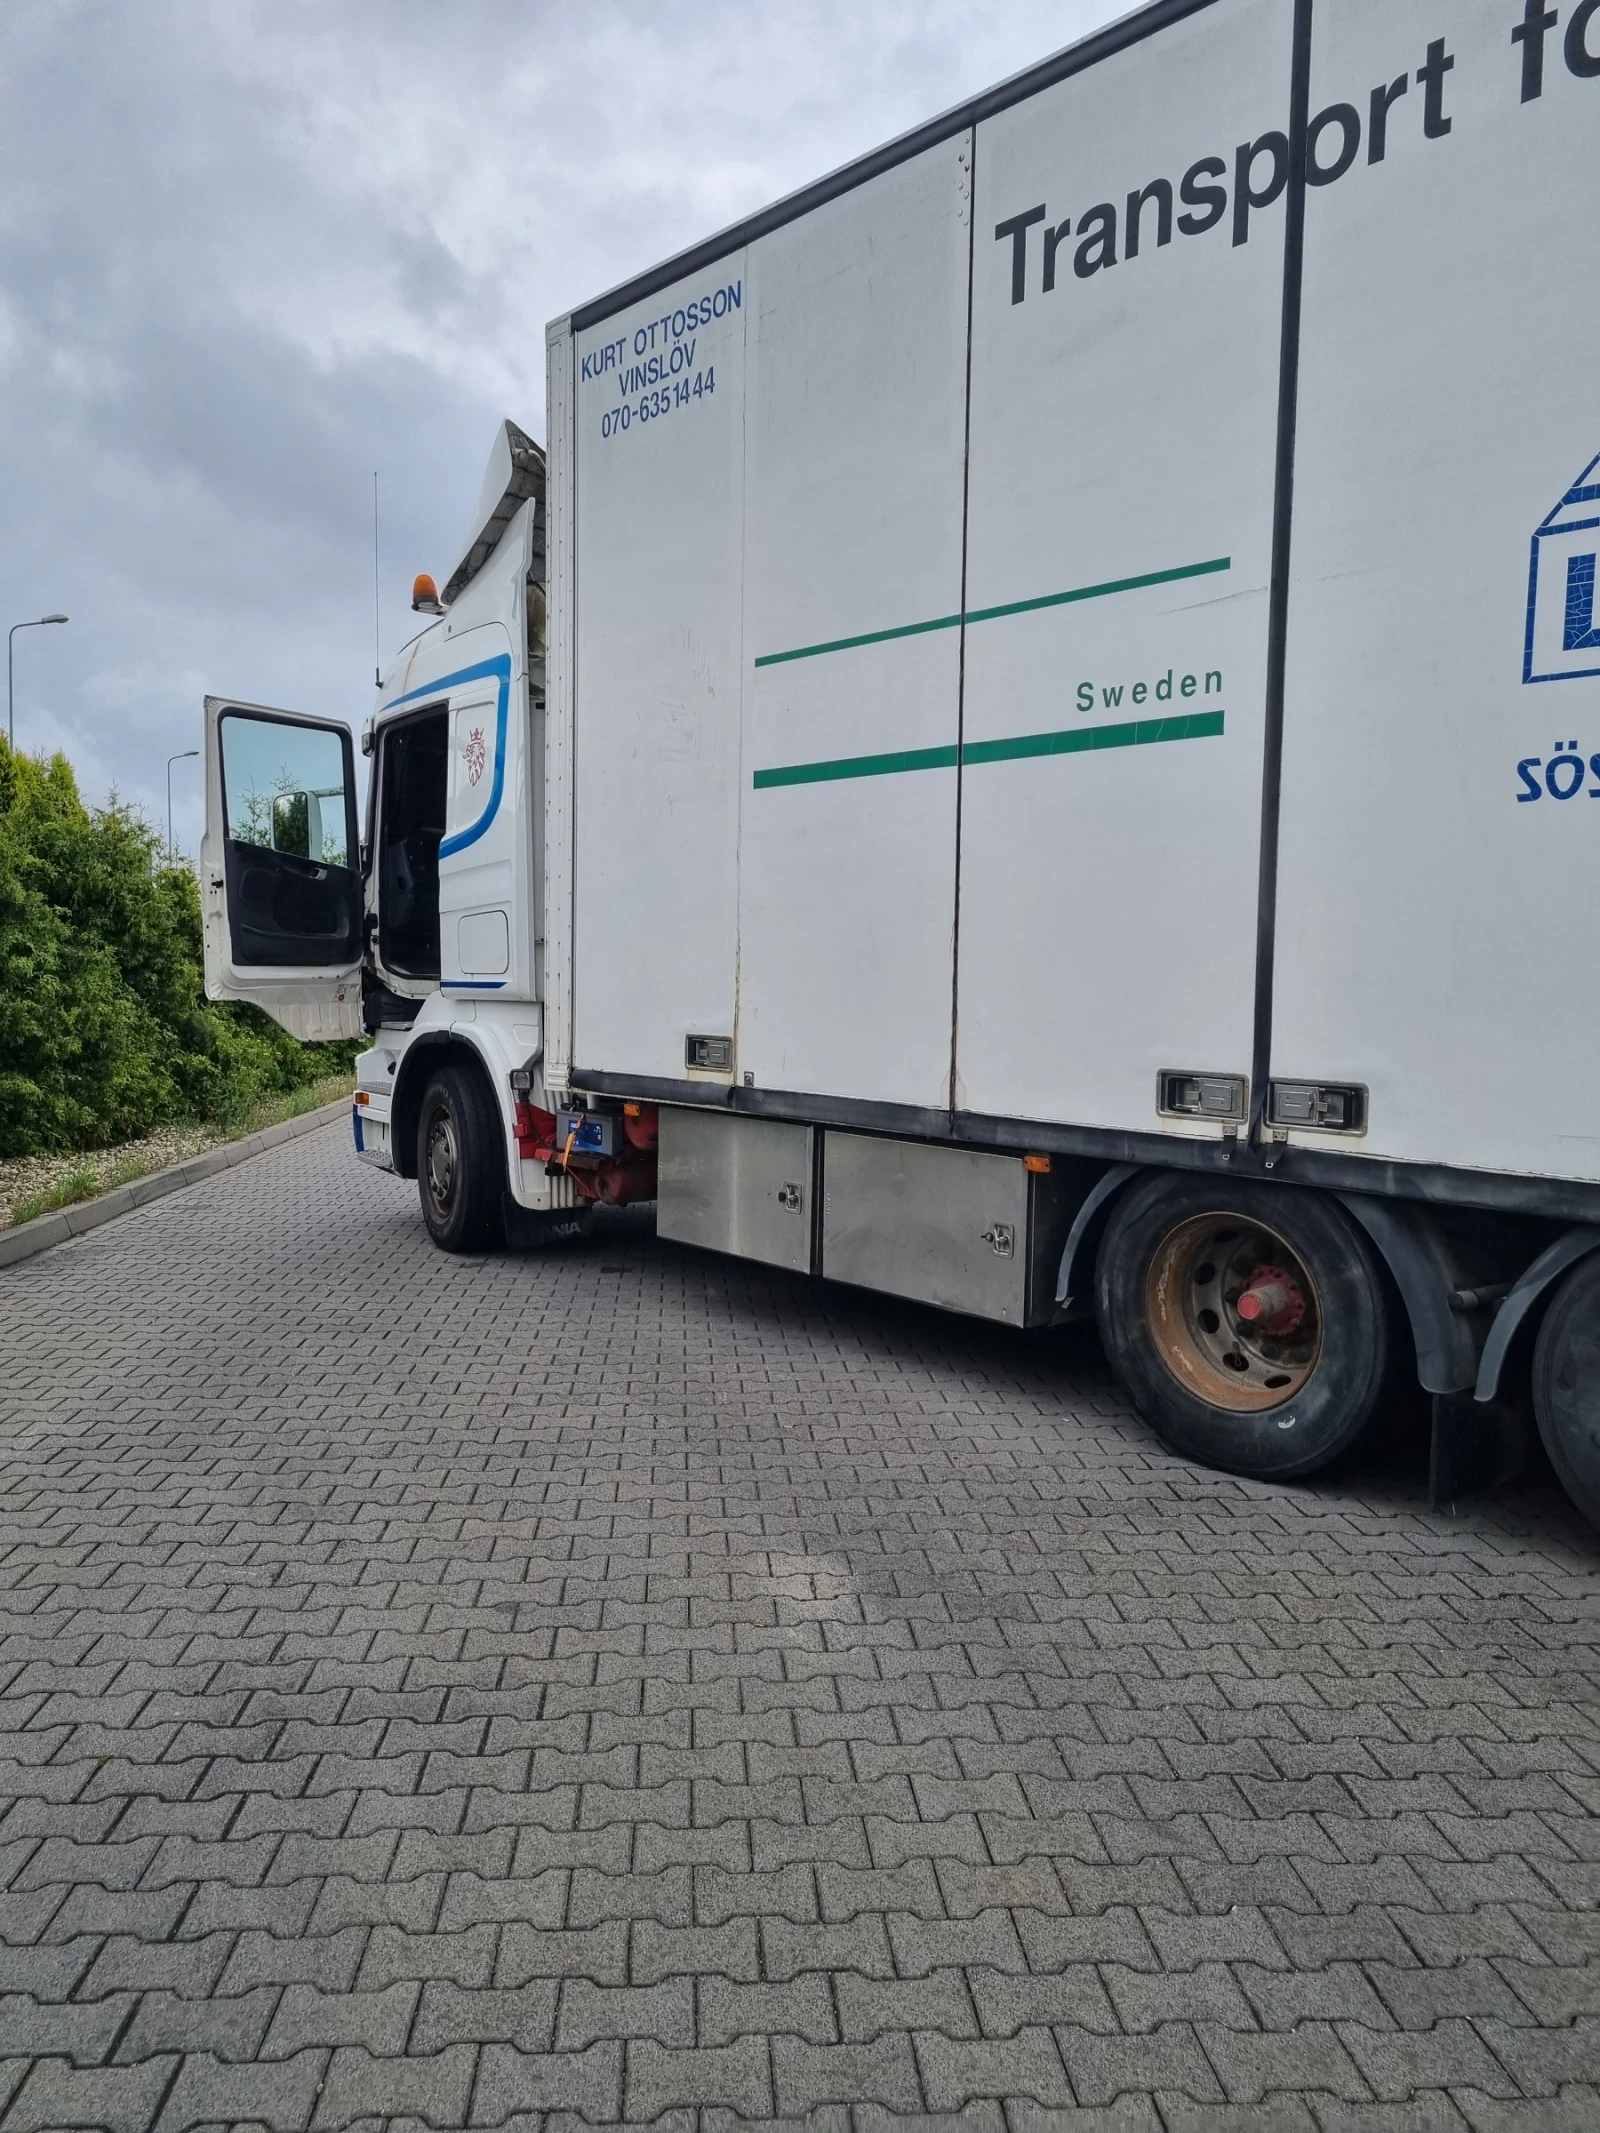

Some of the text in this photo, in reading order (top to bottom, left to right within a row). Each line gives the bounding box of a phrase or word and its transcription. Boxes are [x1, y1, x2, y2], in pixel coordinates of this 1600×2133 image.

[994, 36, 1455, 305] Transport
[581, 280, 742, 382] KURT OTTOSSON
[618, 338, 697, 397] VINSLÖV
[1076, 669, 1222, 712] Sweden
